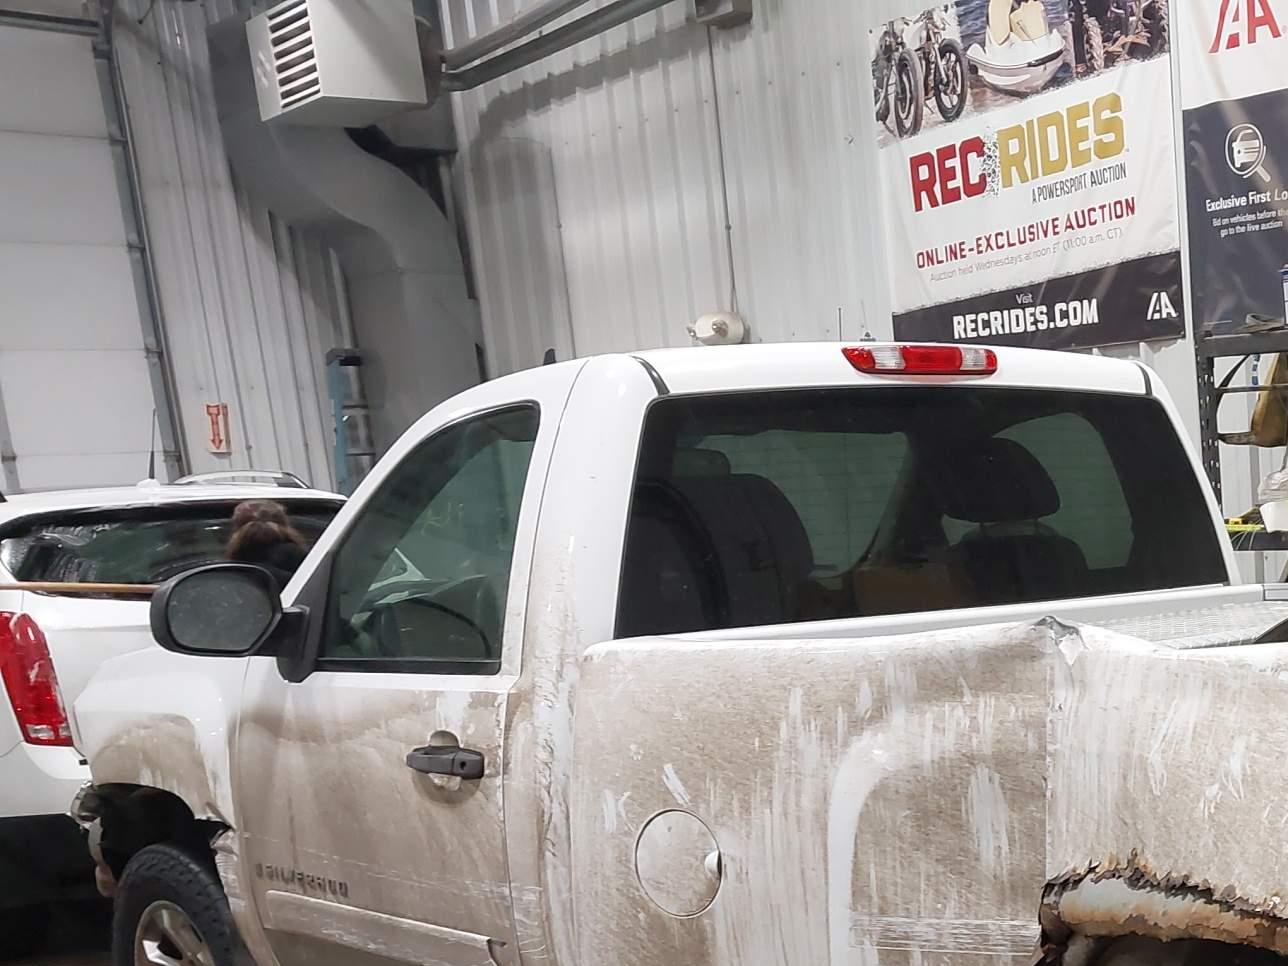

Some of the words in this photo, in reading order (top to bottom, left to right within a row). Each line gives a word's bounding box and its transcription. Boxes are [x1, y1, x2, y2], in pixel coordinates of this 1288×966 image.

[909, 136, 988, 212] REC
[997, 92, 1126, 189] RIDES
[1031, 189, 1037, 204] A
[1038, 174, 1088, 200] POWERSPORT
[1090, 162, 1128, 186] AUCTION
[1205, 194, 1247, 212] Exclusive
[1248, 190, 1272, 205] First
[1229, 227, 1235, 235] to
[1236, 225, 1246, 234] the
[1247, 223, 1260, 232] live
[1261, 220, 1283, 230] auction
[1230, 213, 1256, 223] vehicles
[1256, 210, 1277, 220] before
[916, 217, 1061, 269] ONLINE-EXCLUSIVE
[1064, 196, 1136, 233] AUCTION
[930, 268, 956, 282] Auction
[958, 264, 974, 278] held
[975, 254, 1023, 272] Wednesdays
[1015, 293, 1034, 304] Visit
[953, 298, 1099, 340] RECRIDES.COM
